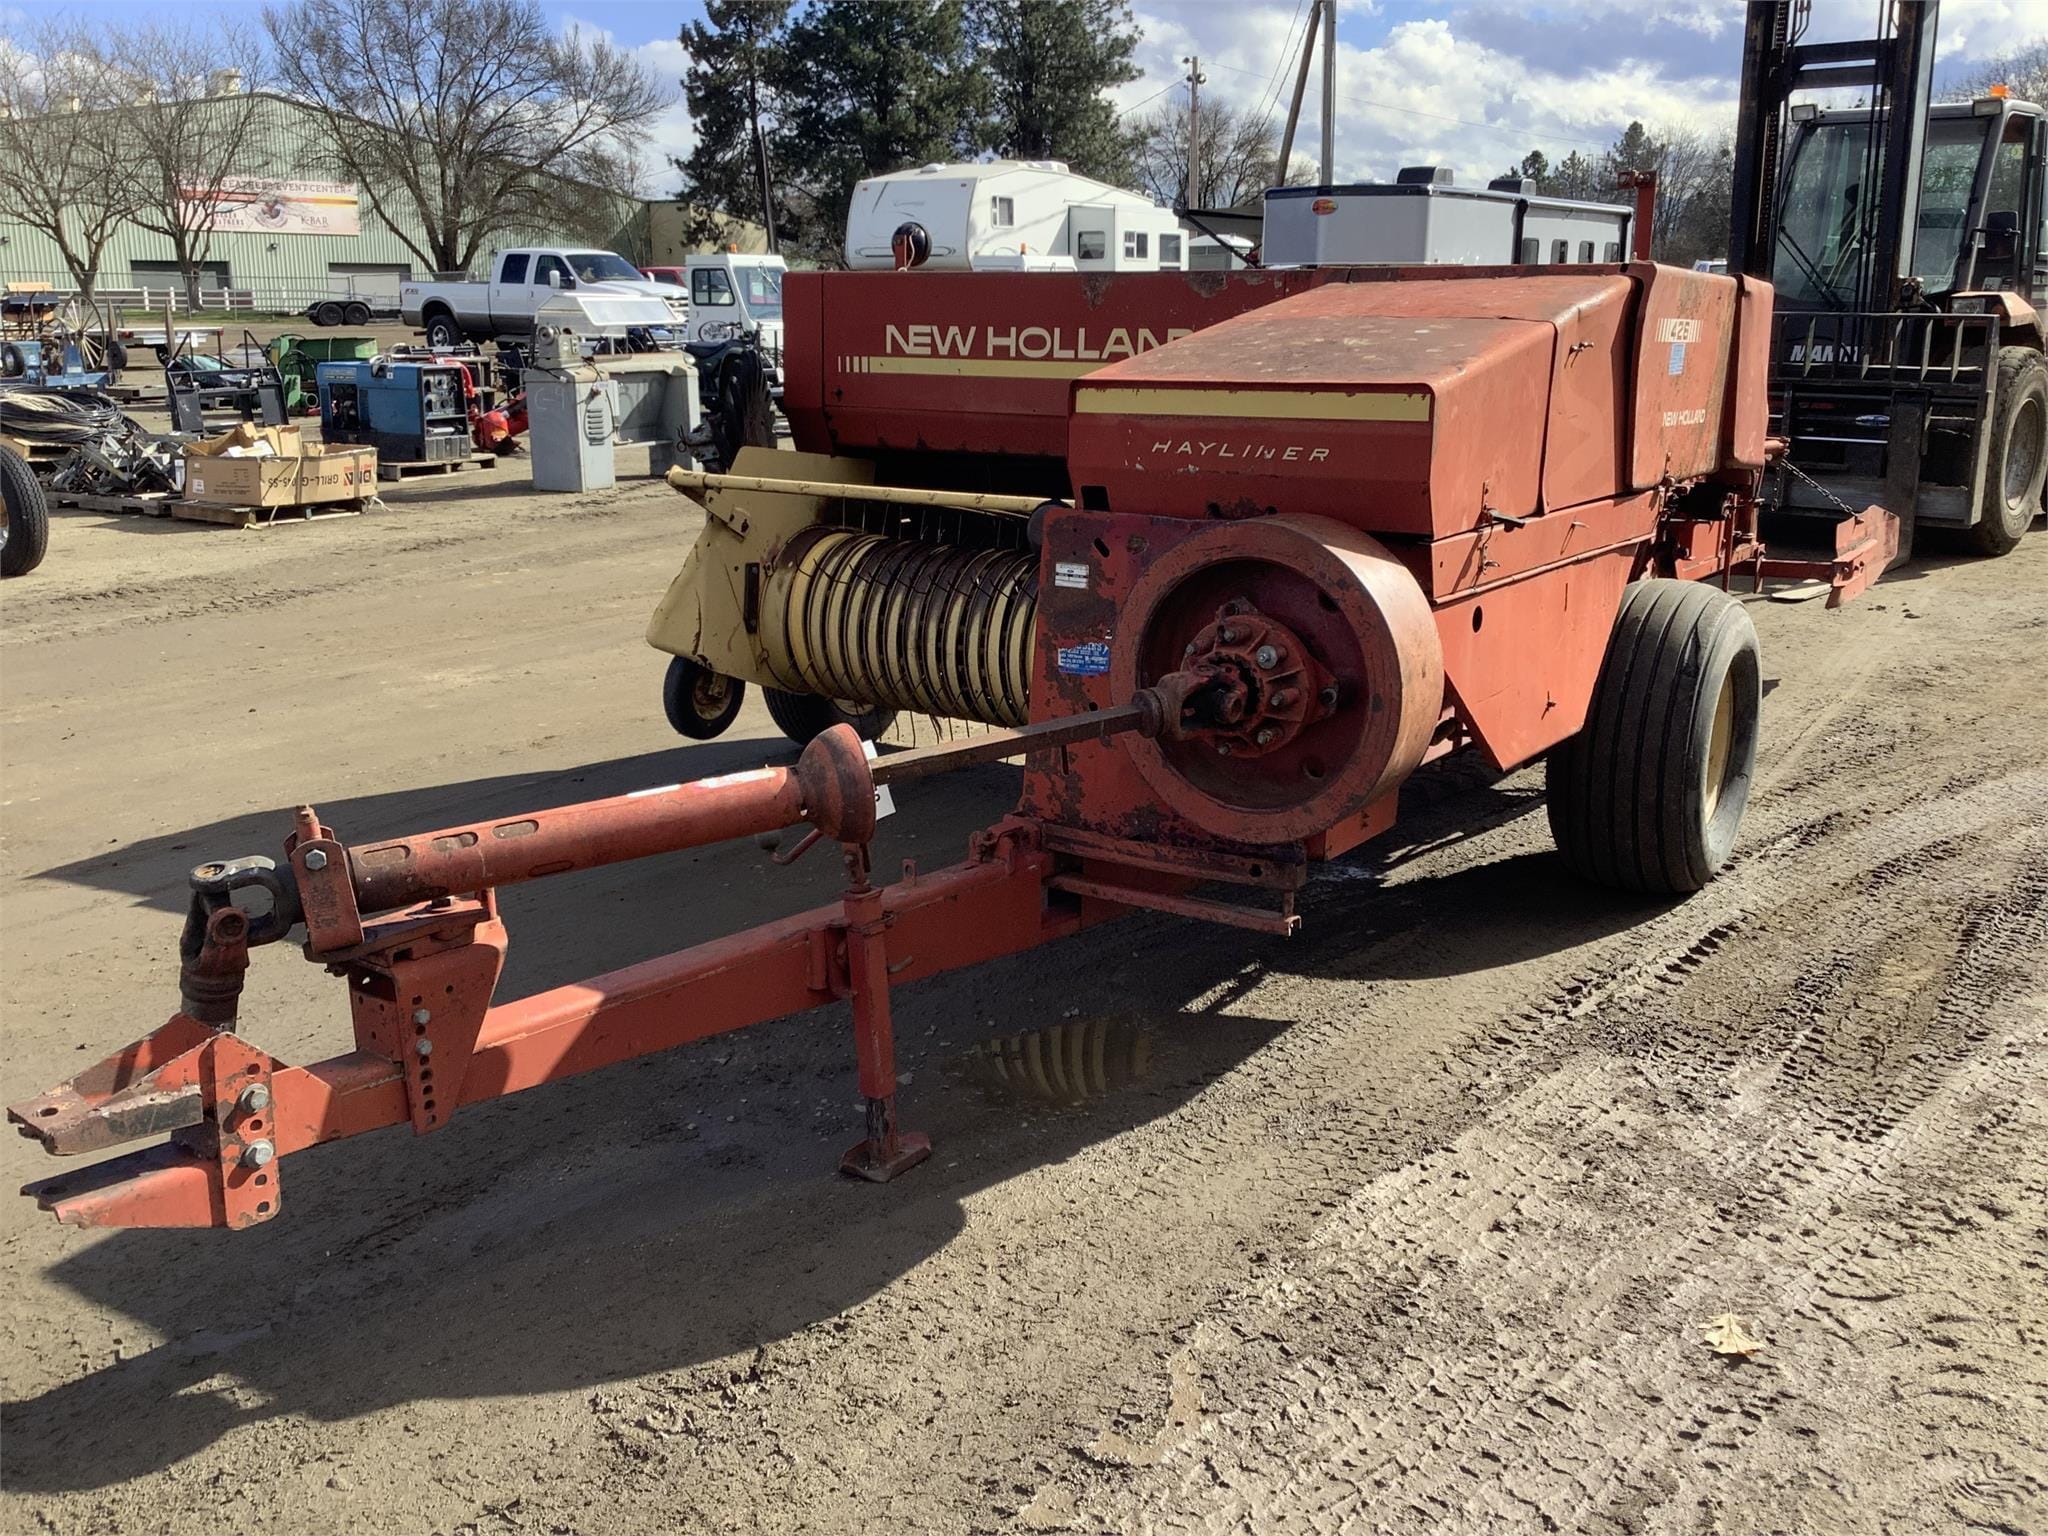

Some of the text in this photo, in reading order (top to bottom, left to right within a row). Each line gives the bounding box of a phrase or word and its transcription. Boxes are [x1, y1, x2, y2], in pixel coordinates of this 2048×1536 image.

[309, 184, 346, 194] CENTER
[885, 324, 977, 356] NEW
[1678, 409, 1706, 425] HOLLAND
[1151, 440, 1330, 462] HAYLINER
